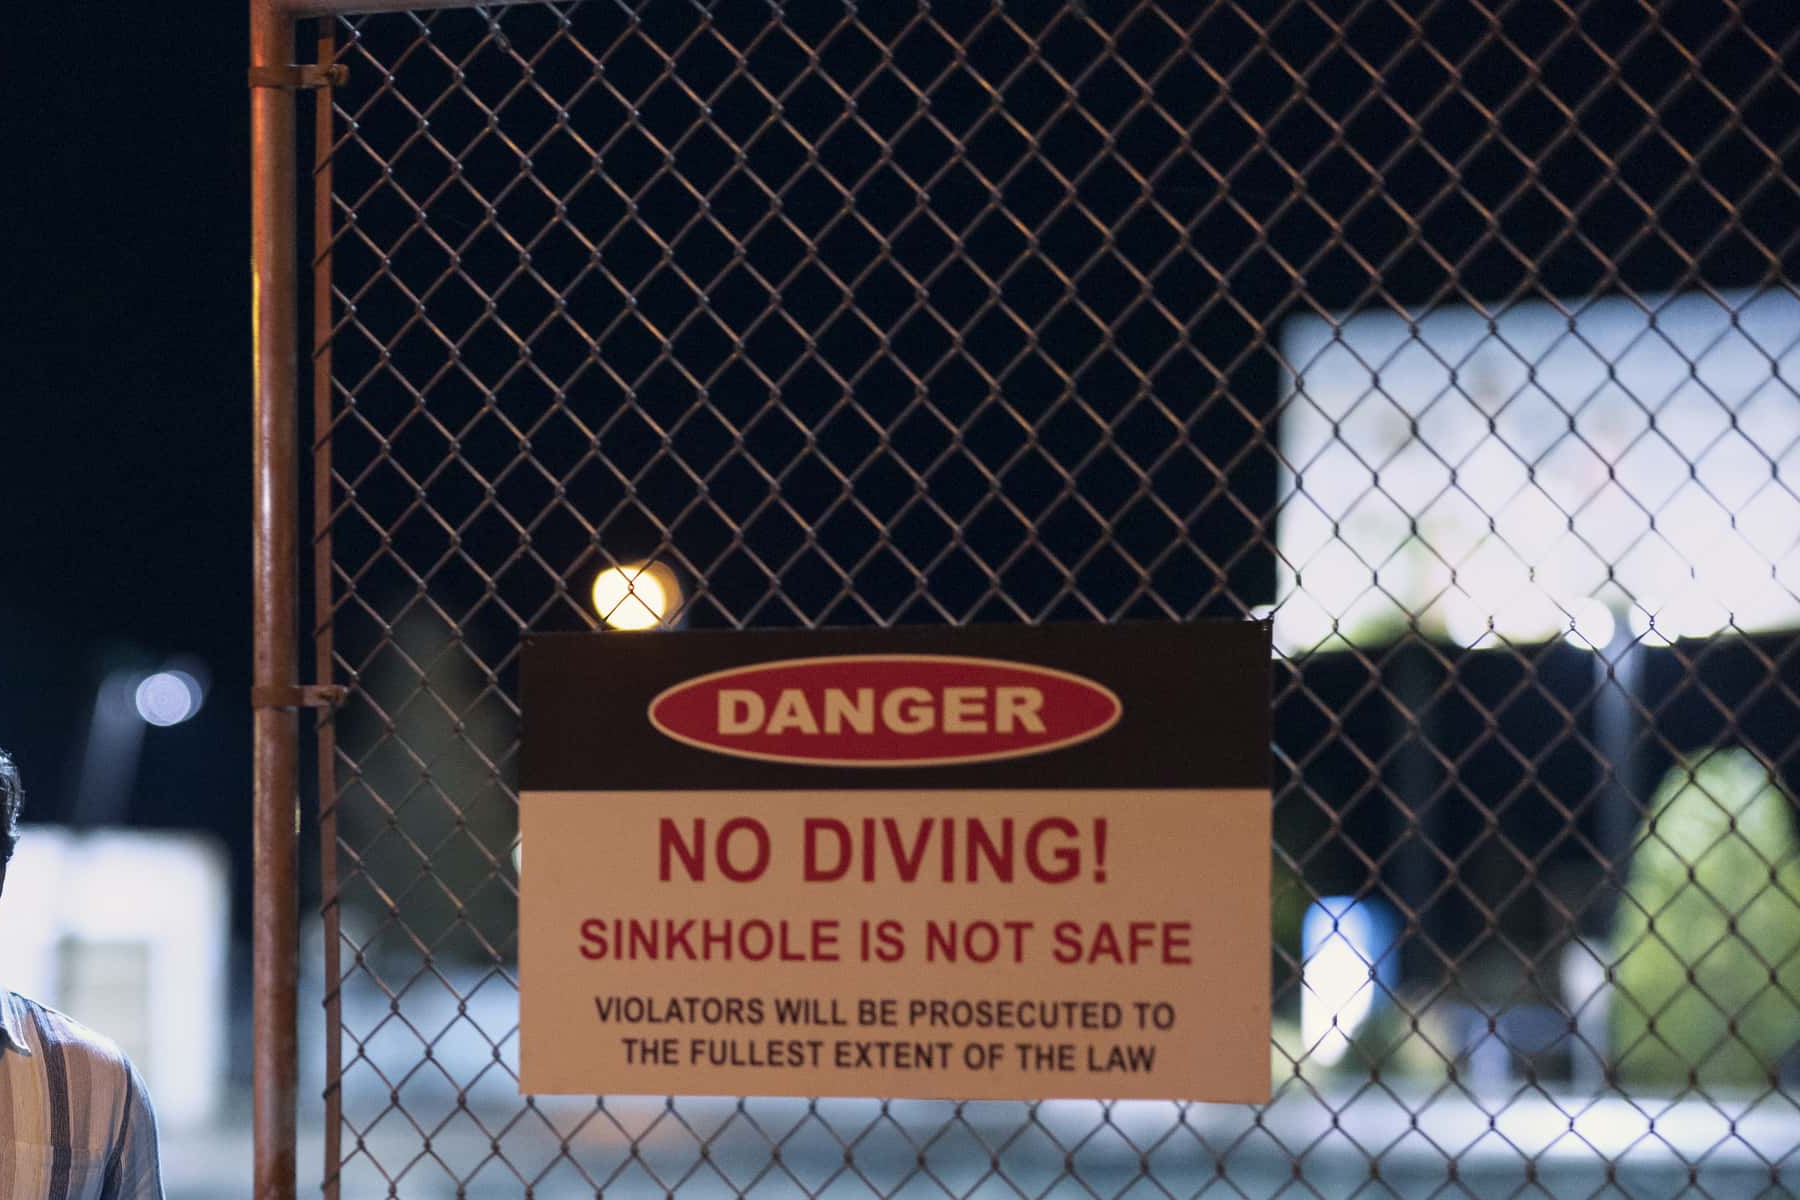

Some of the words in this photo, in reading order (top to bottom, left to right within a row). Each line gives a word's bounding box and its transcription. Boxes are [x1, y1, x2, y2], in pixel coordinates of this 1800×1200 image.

[716, 686, 1047, 735] DANGER
[658, 817, 771, 883] NO
[803, 817, 1109, 884] DIVING!
[578, 918, 841, 963] SINKHOLE
[860, 920, 906, 963] IS
[926, 920, 1034, 964] NOT
[1053, 920, 1193, 965] SAFE
[594, 996, 765, 1026] VIOLATORS
[775, 997, 848, 1027] WILL
[858, 998, 898, 1028] BE
[908, 1000, 1124, 1030] PROSECUTED
[1132, 1001, 1176, 1031] TO
[620, 1038, 681, 1066] THE
[689, 1039, 824, 1069] FULLEST
[835, 1041, 951, 1070] EXTENT
[960, 1042, 1005, 1071] OF
[1016, 1043, 1077, 1072] THE
[1087, 1044, 1156, 1073] LAW
